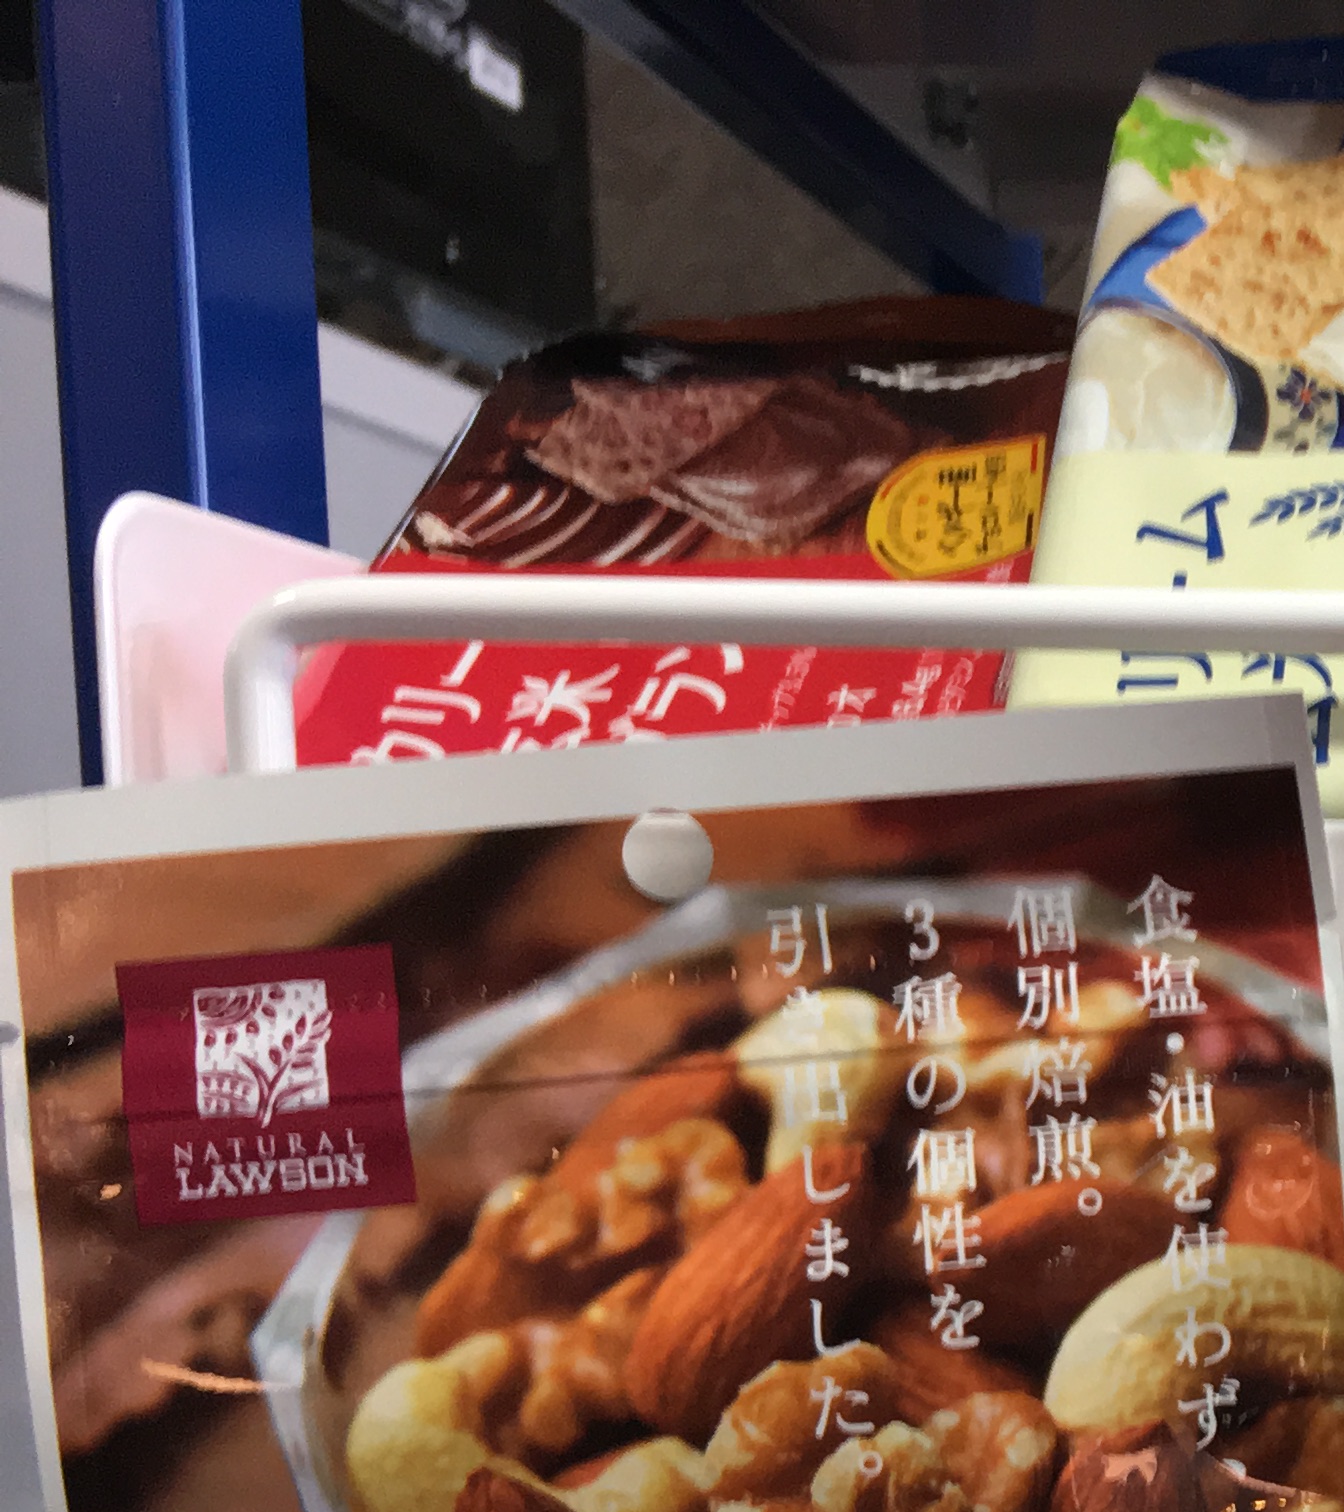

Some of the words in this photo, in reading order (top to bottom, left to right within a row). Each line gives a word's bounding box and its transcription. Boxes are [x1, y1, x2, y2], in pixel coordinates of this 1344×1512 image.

[173, 1128, 365, 1166] NATURAL
[176, 1153, 368, 1201] LAWSON
[767, 903, 883, 1477] 引き出しました。
[894, 898, 986, 1350] 3種の個性を
[1009, 886, 1103, 1216] 個別焙煎。
[1127, 874, 1247, 1478] 食塩・油を使わず、
